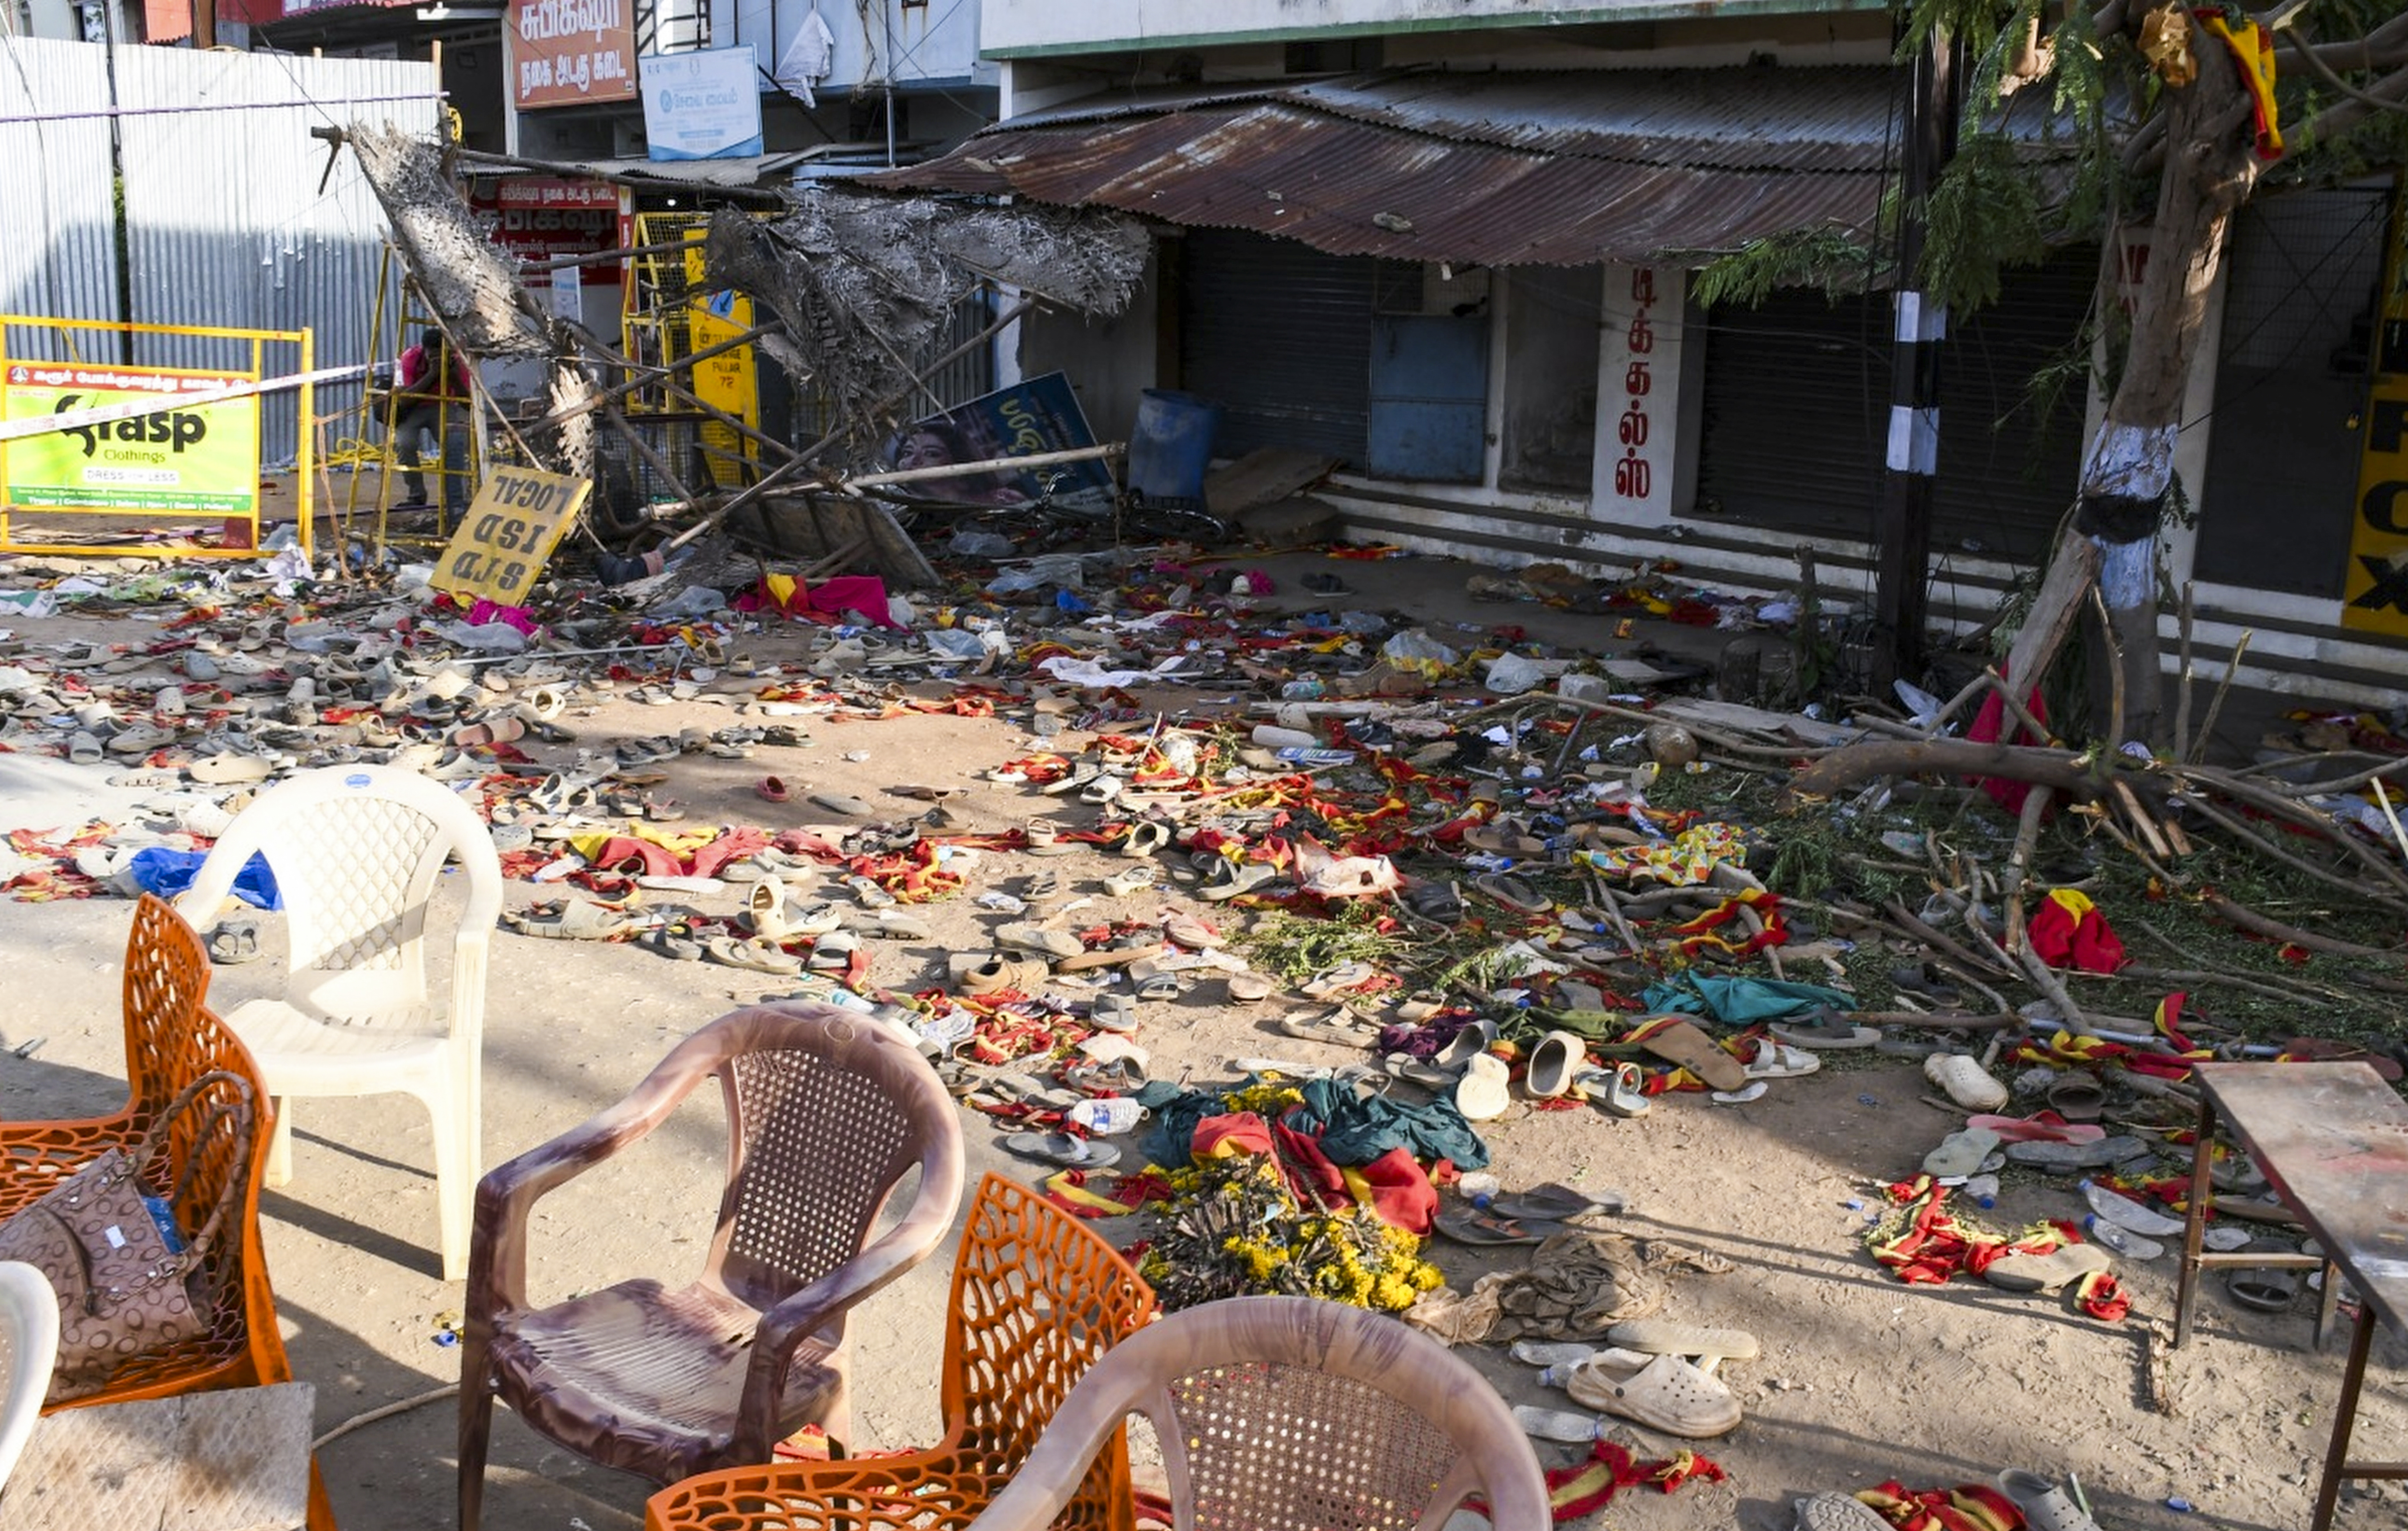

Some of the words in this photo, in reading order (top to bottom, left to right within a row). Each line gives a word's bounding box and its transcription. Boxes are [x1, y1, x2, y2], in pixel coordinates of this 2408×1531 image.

[520, 59, 552, 99] நகை
[555, 53, 589, 92] அடகு
[593, 49, 627, 80] கடை
[719, 377, 734, 388] 72
[87, 470, 124, 481] DRESS
[104, 449, 165, 464] Clothings
[493, 475, 572, 515] LOCAL
[474, 514, 547, 555] ISD
[453, 551, 526, 590] STD
